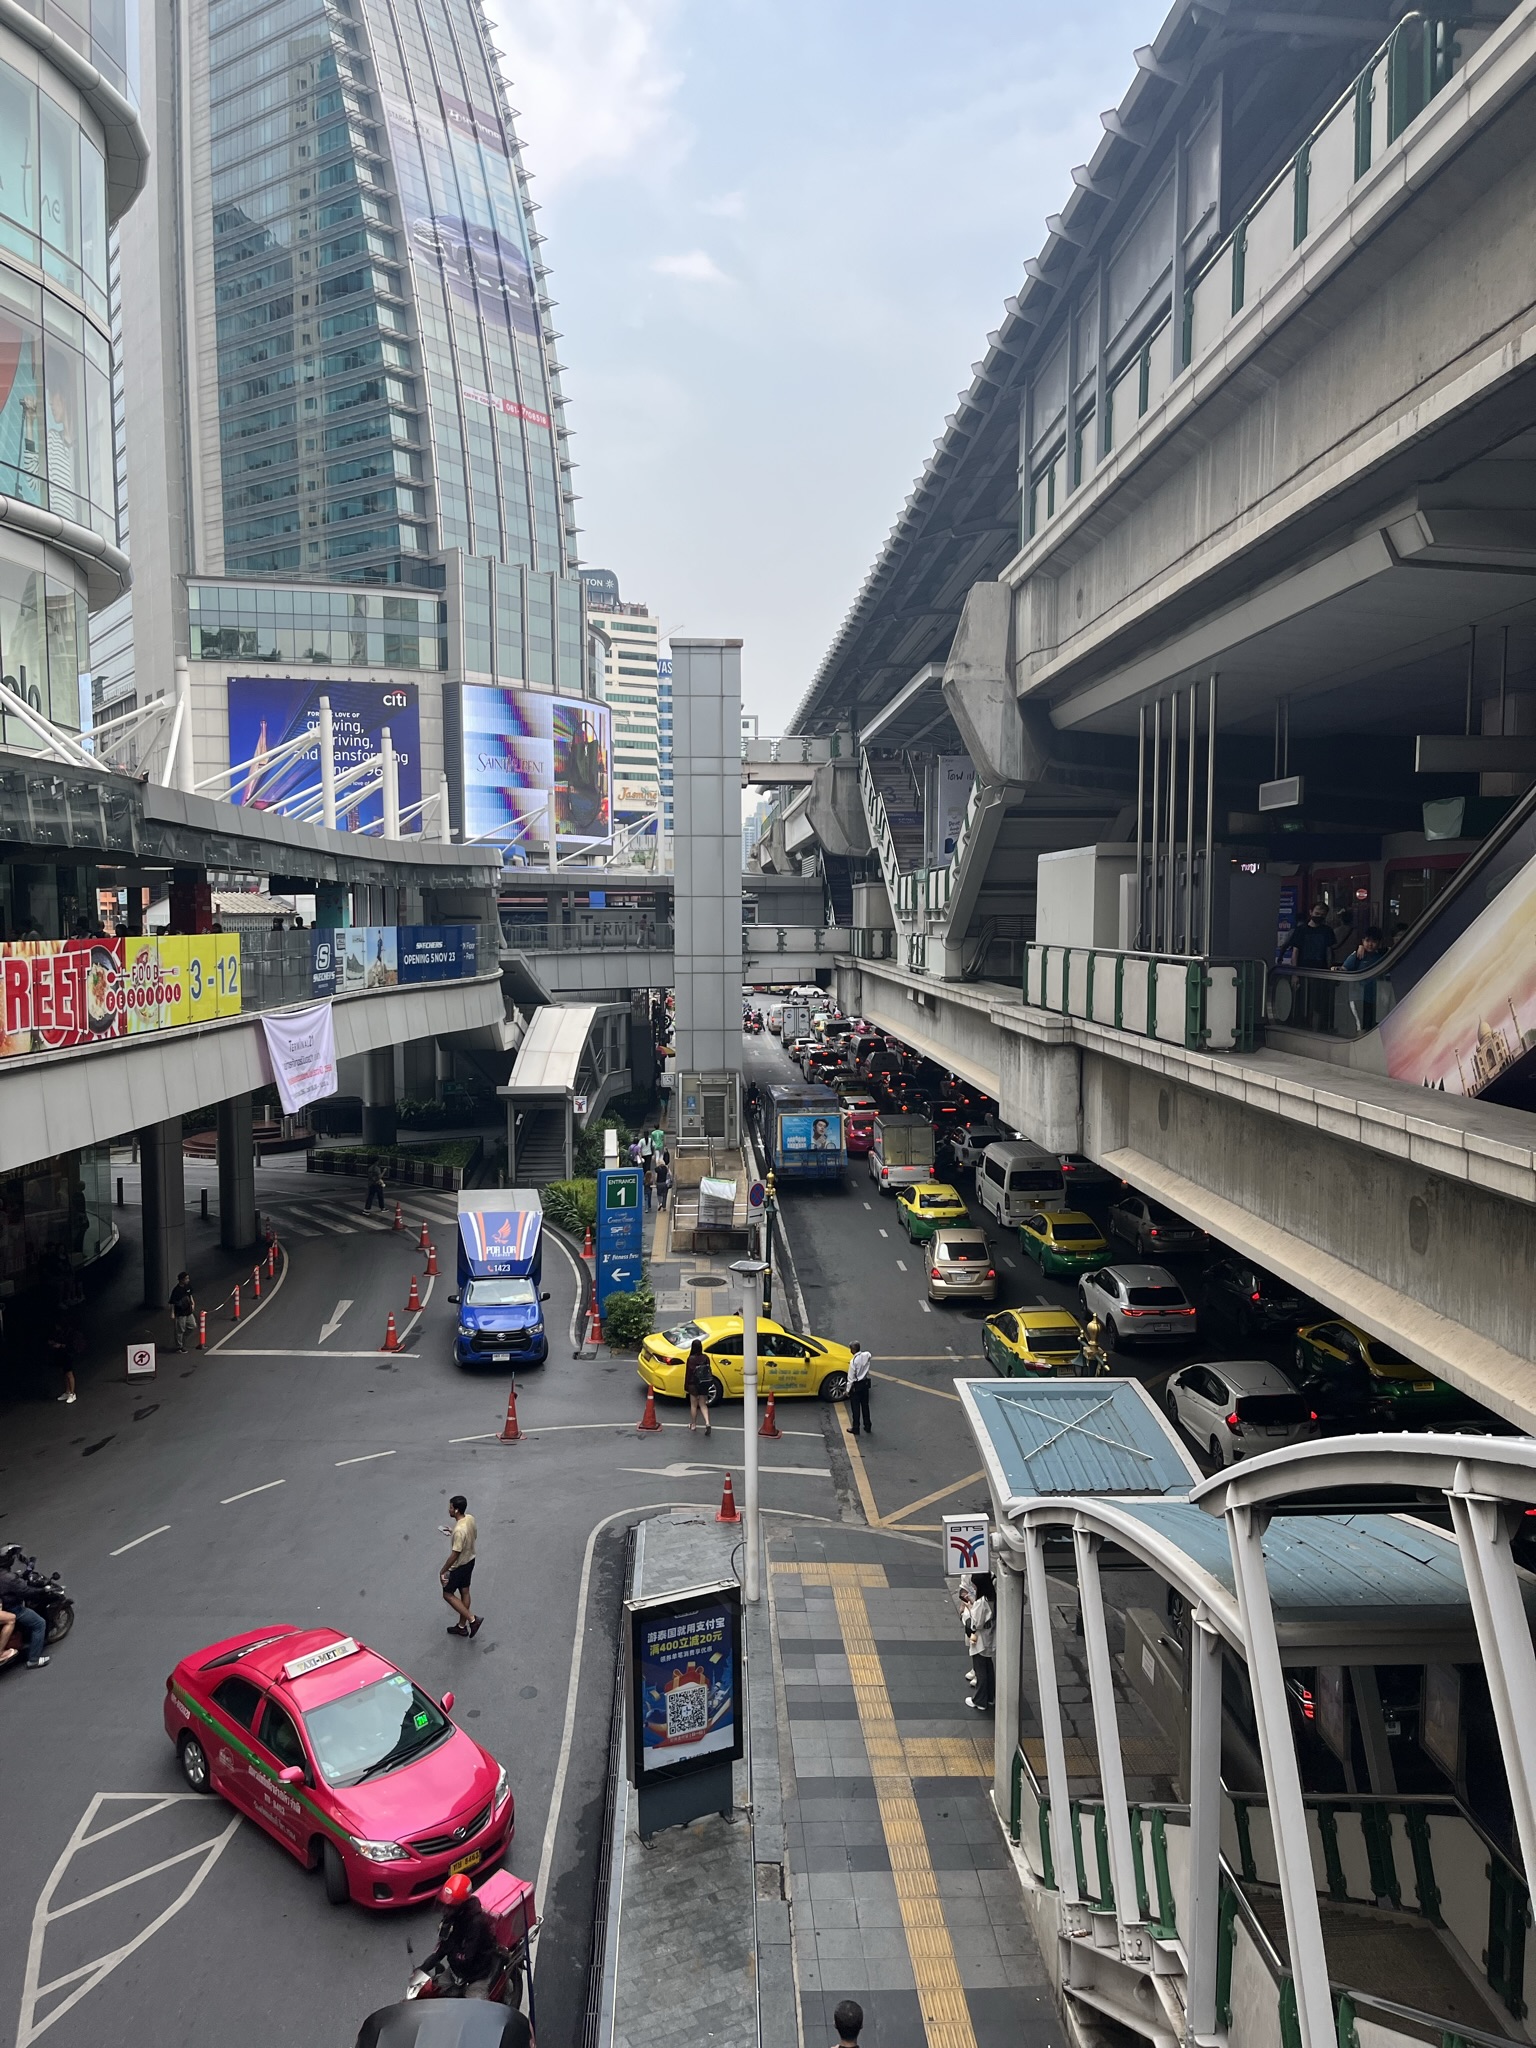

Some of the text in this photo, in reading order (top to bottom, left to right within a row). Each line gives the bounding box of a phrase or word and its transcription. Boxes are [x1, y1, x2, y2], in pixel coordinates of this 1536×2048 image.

[382, 694, 407, 707] citi
[403, 954, 430, 965] OPENING
[448, 951, 456, 962] 23
[107, 984, 181, 1011] FESTIVAL
[608, 1178, 636, 1186] ENTRANCE
[616, 1186, 626, 1206] 1
[486, 1245, 500, 1255] POR
[502, 1245, 517, 1254] LOR
[494, 1264, 511, 1272] 1423
[950, 1525, 984, 1533] BTS
[647, 1617, 726, 1644] 游泰国就用支付宝
[649, 1630, 723, 1657] 满400立减20元
[296, 1645, 349, 1671] TAXI-METER
